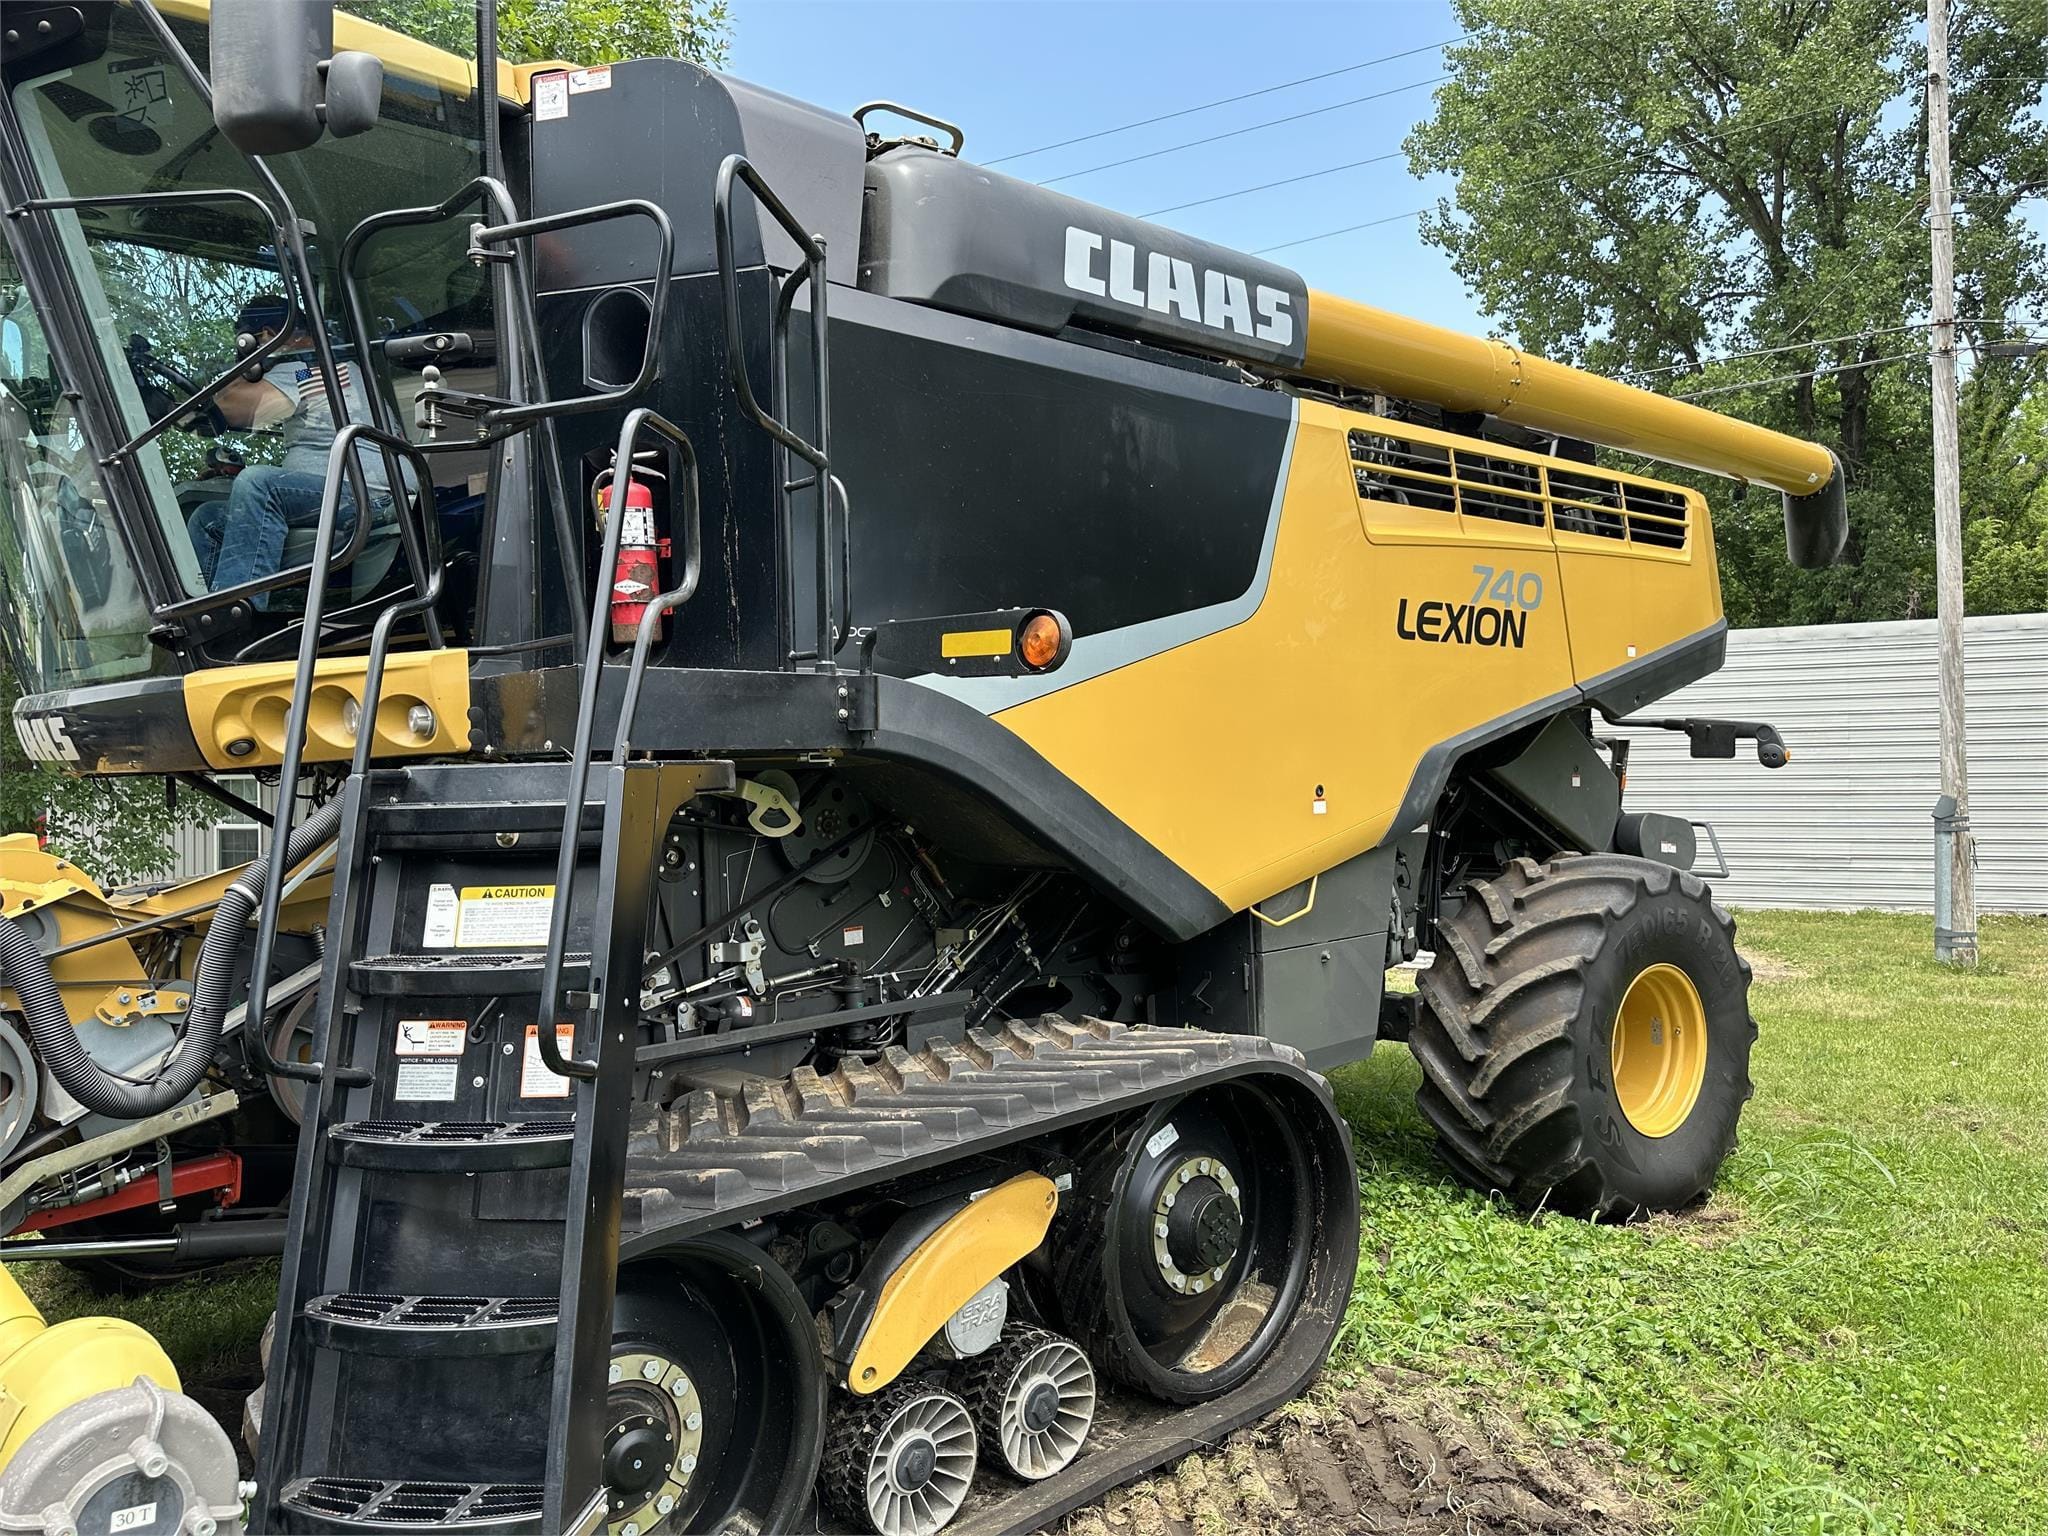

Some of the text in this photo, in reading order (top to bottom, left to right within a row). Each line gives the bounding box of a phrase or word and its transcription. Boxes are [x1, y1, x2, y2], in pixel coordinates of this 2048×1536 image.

[1064, 226, 1293, 347] CLAAS
[1471, 564, 1543, 611] 740
[1397, 598, 1527, 649] LEXION
[494, 887, 546, 898] CAUTION
[960, 1306, 1001, 1335] TRAC
[115, 1507, 152, 1528] 30 T
